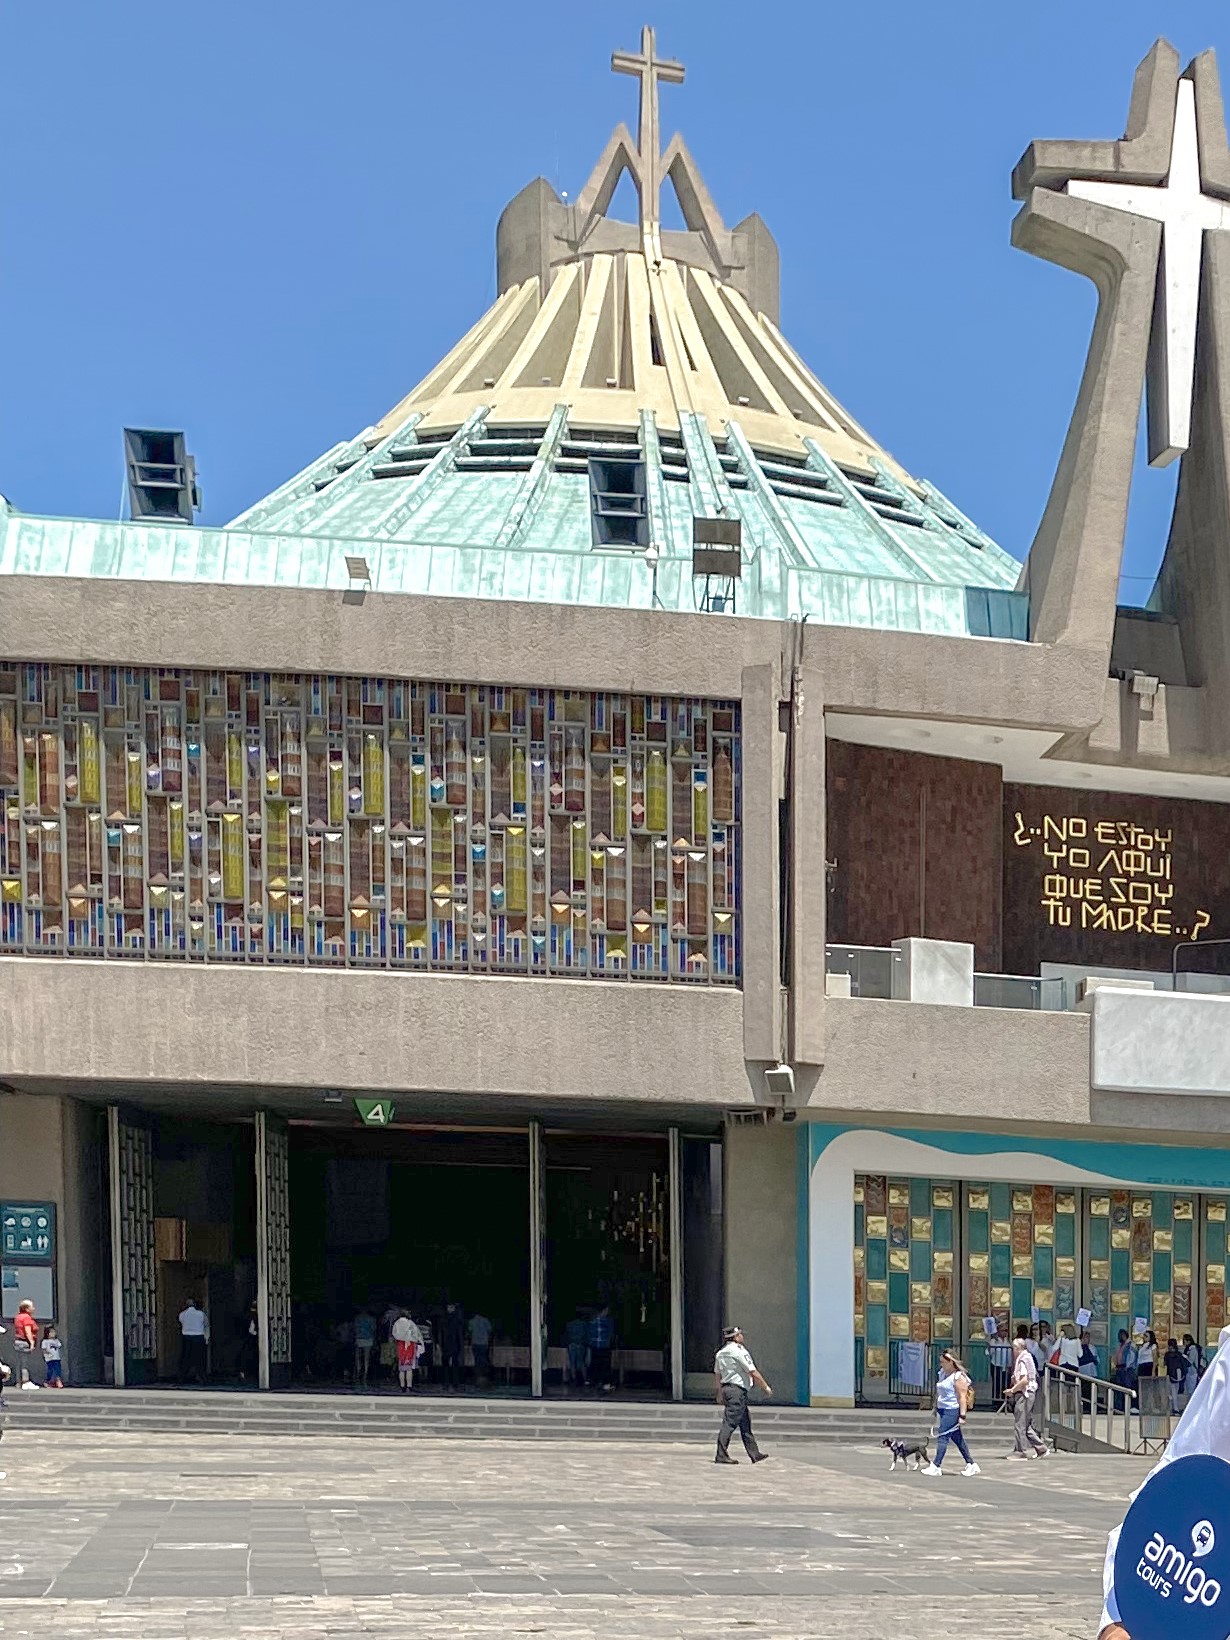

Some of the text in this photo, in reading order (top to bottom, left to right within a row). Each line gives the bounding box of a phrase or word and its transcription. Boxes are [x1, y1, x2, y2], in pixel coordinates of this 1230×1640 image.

[1044, 843, 1090, 869] YO
[1044, 874, 1173, 905] QUE SOY
[1041, 898, 1071, 926] TU
[367, 1103, 385, 1124] 4
[1137, 1557, 1173, 1598] tours
[1144, 1532, 1221, 1606] amigo
